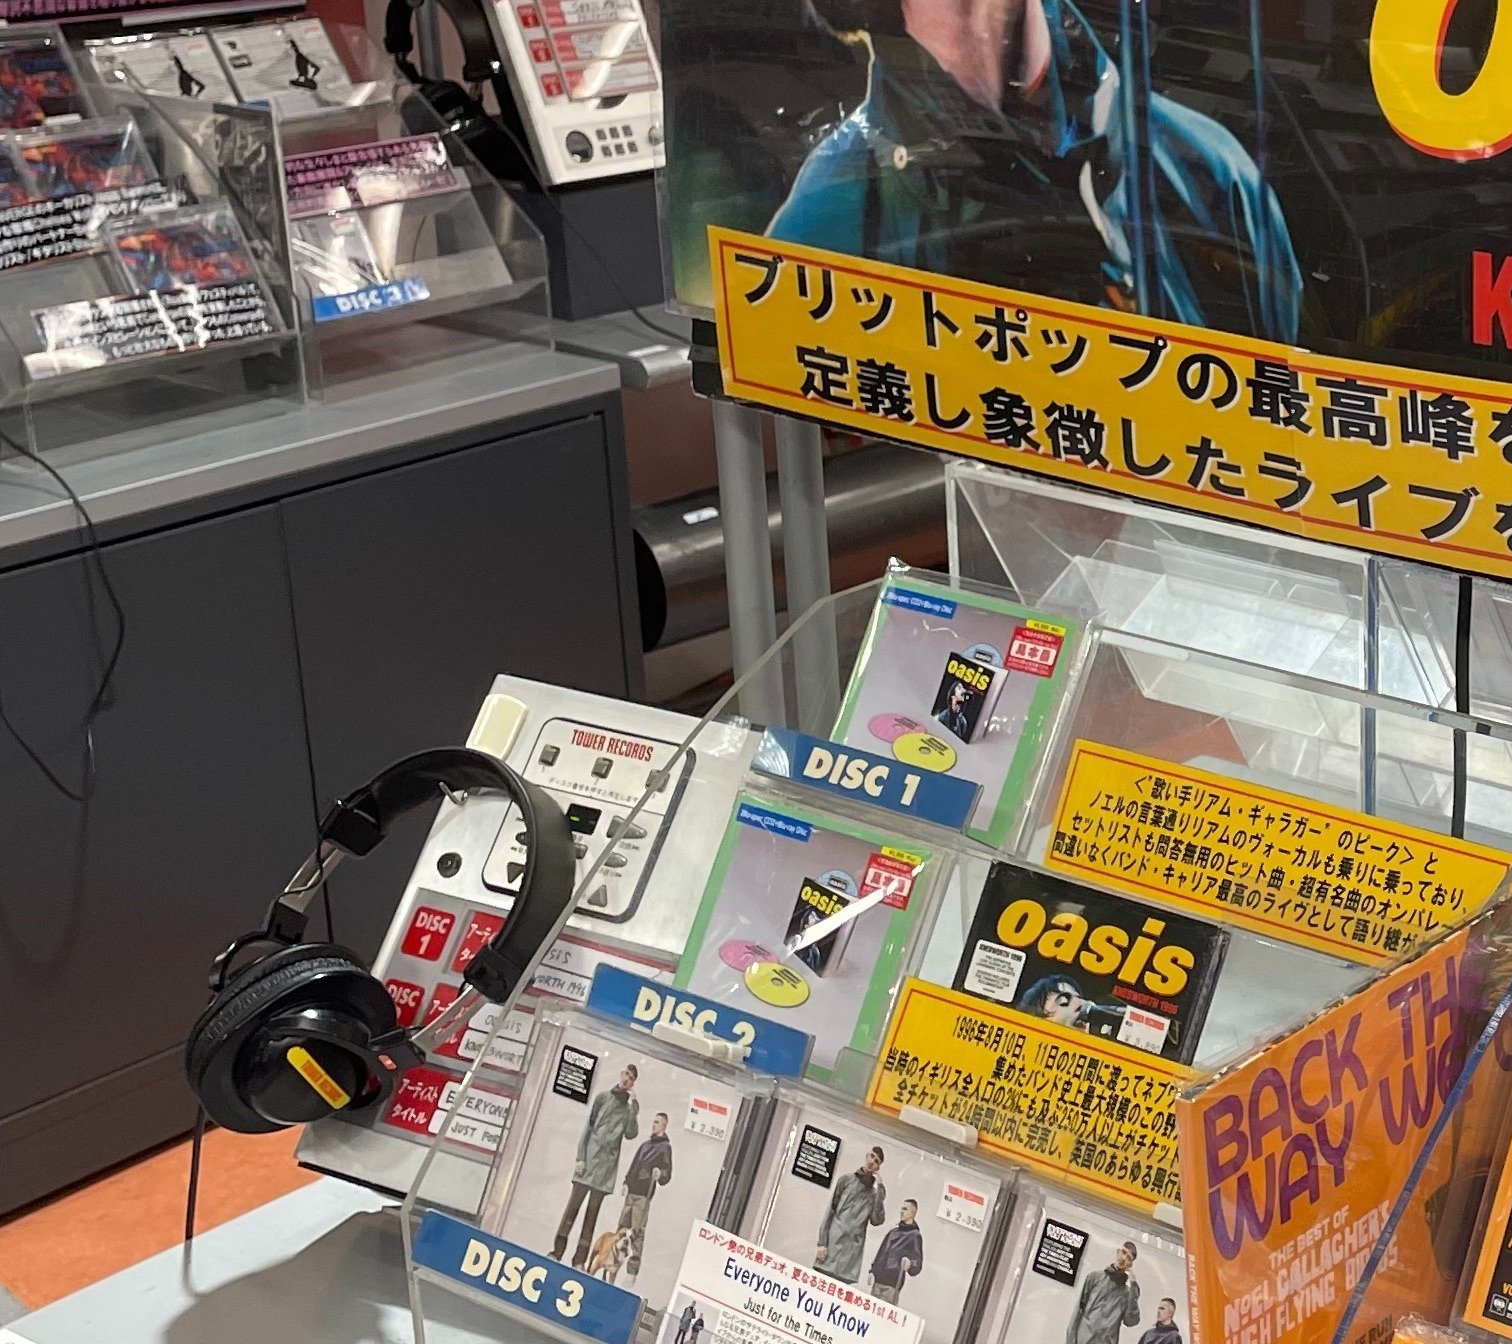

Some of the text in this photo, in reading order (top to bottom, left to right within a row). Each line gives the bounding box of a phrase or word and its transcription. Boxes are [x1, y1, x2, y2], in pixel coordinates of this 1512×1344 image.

[947, 658, 991, 692] oasis
[571, 729, 654, 762] TOWER RECORDS
[803, 746, 922, 807] DISC 1
[416, 910, 451, 935] DISC
[419, 934, 432, 955] 1
[996, 897, 1195, 999] oasis
[633, 985, 756, 1059] DISC 2
[450, 1119, 475, 1138] JUST
[1204, 1012, 1369, 1189] BACK
[1209, 1101, 1353, 1260] WAY
[460, 1236, 585, 1318] DISC 3
[723, 1256, 871, 1338] Everyone You Know
[1276, 1271, 1336, 1338] FLYING
[743, 1296, 766, 1318] Just
[767, 1305, 783, 1325] for
[784, 1312, 801, 1334] the
